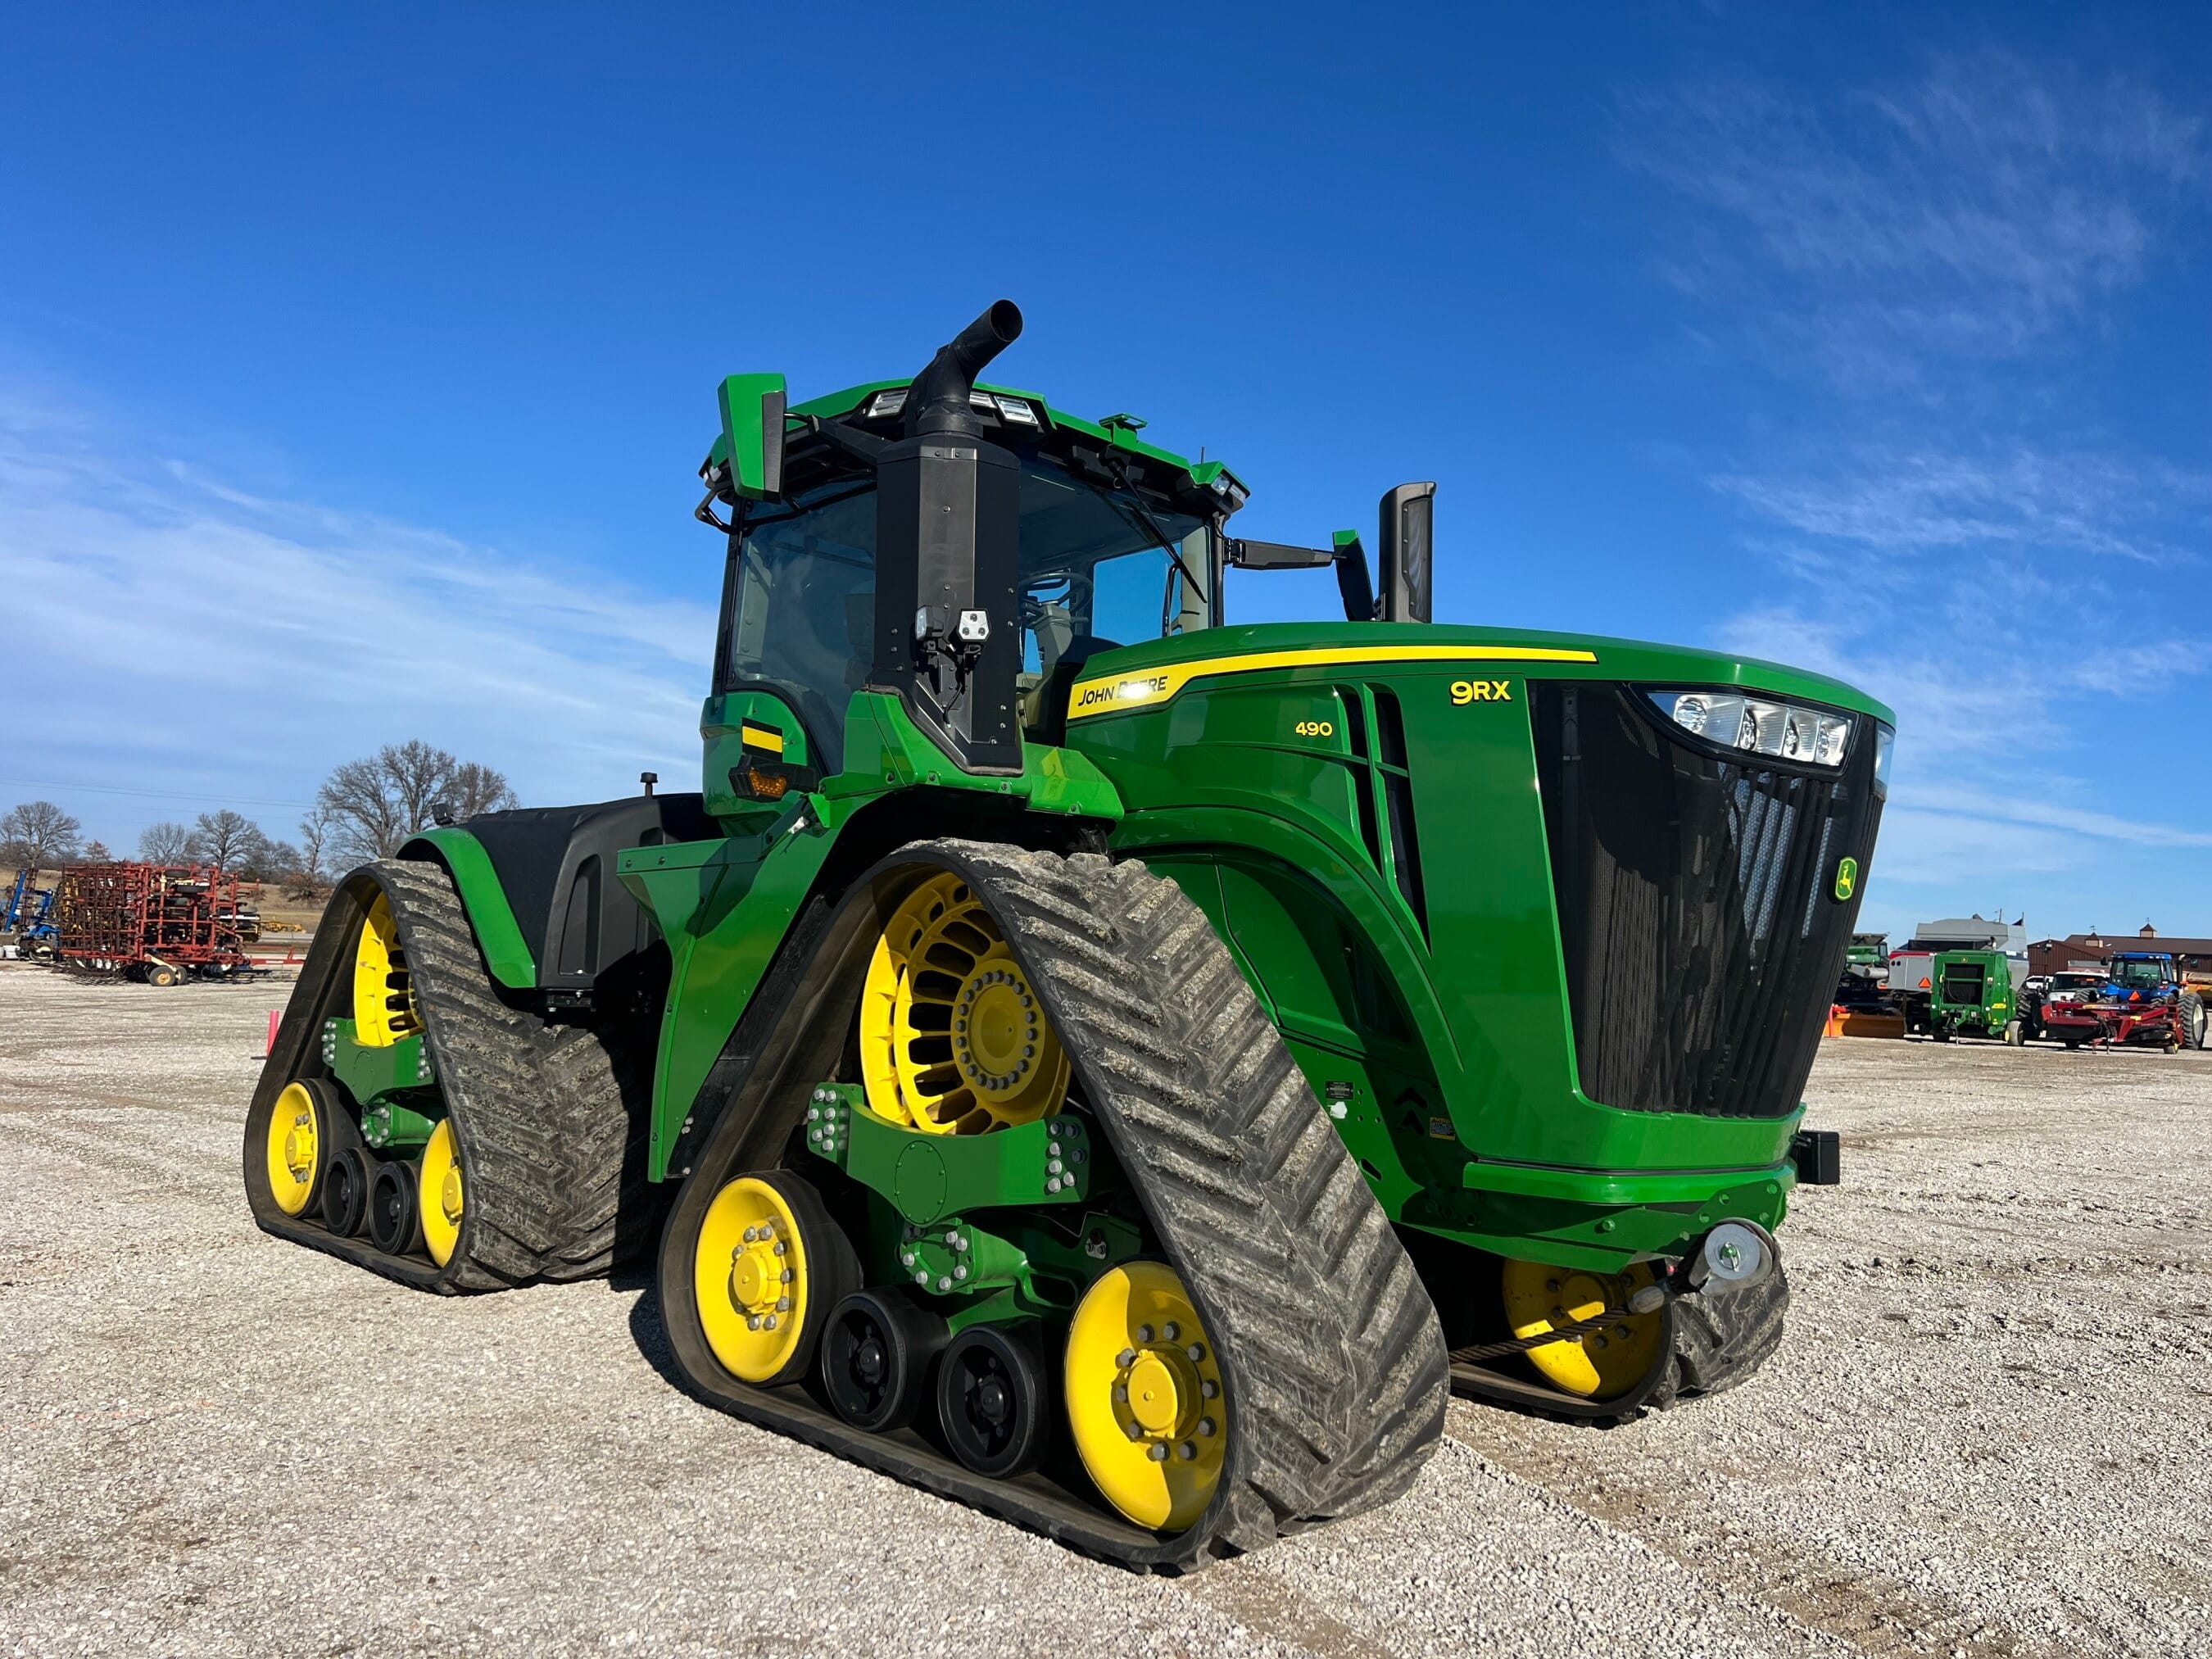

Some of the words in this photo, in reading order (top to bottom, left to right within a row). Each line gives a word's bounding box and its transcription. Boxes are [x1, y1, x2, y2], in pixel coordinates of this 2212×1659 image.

[1077, 687, 1115, 706] JOHN
[1117, 676, 1168, 699] DRE
[1450, 681, 1512, 705] 9RX
[1295, 721, 1333, 737] 490
